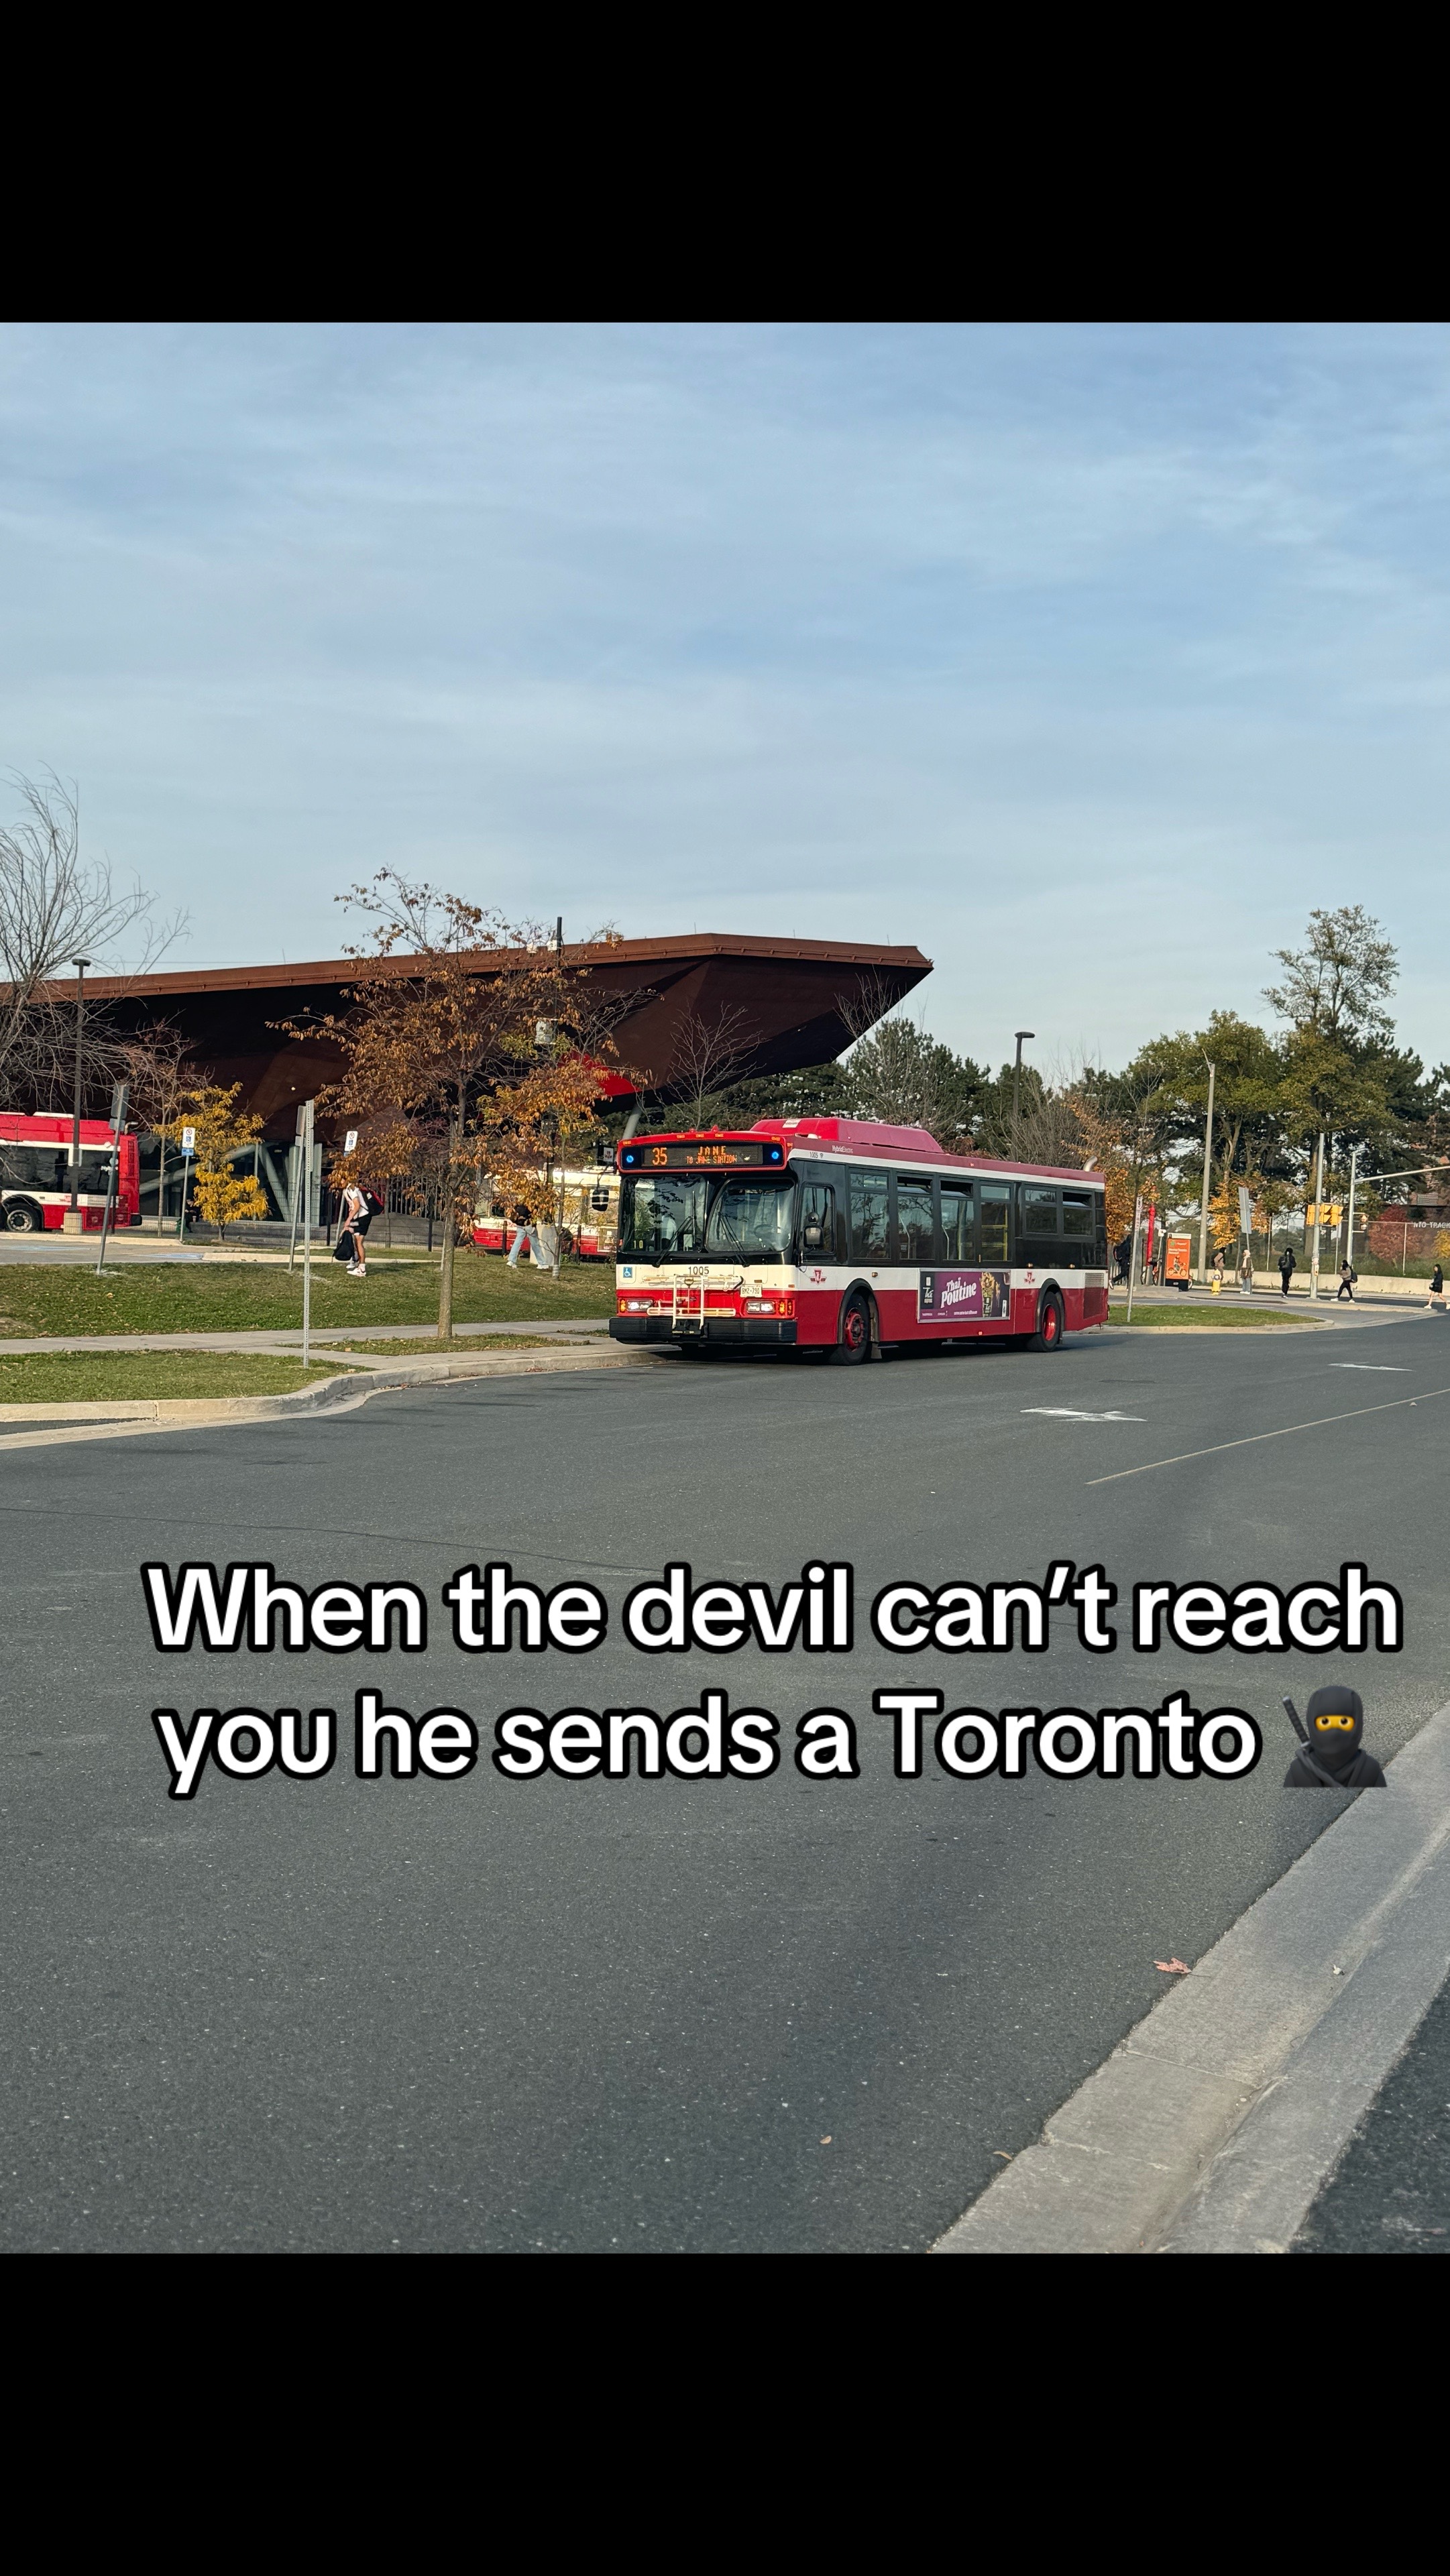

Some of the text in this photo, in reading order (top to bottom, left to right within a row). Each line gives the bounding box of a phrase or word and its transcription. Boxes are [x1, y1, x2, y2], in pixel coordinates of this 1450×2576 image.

[698, 1145, 726, 1155] JANE
[652, 1147, 668, 1165] 35
[686, 1156, 693, 1164] TO
[713, 1155, 737, 1164] STATION
[633, 1240, 643, 1249] 10
[687, 1266, 710, 1275] 1005
[946, 1277, 962, 1293] Thai
[940, 1281, 977, 1309] Poutine
